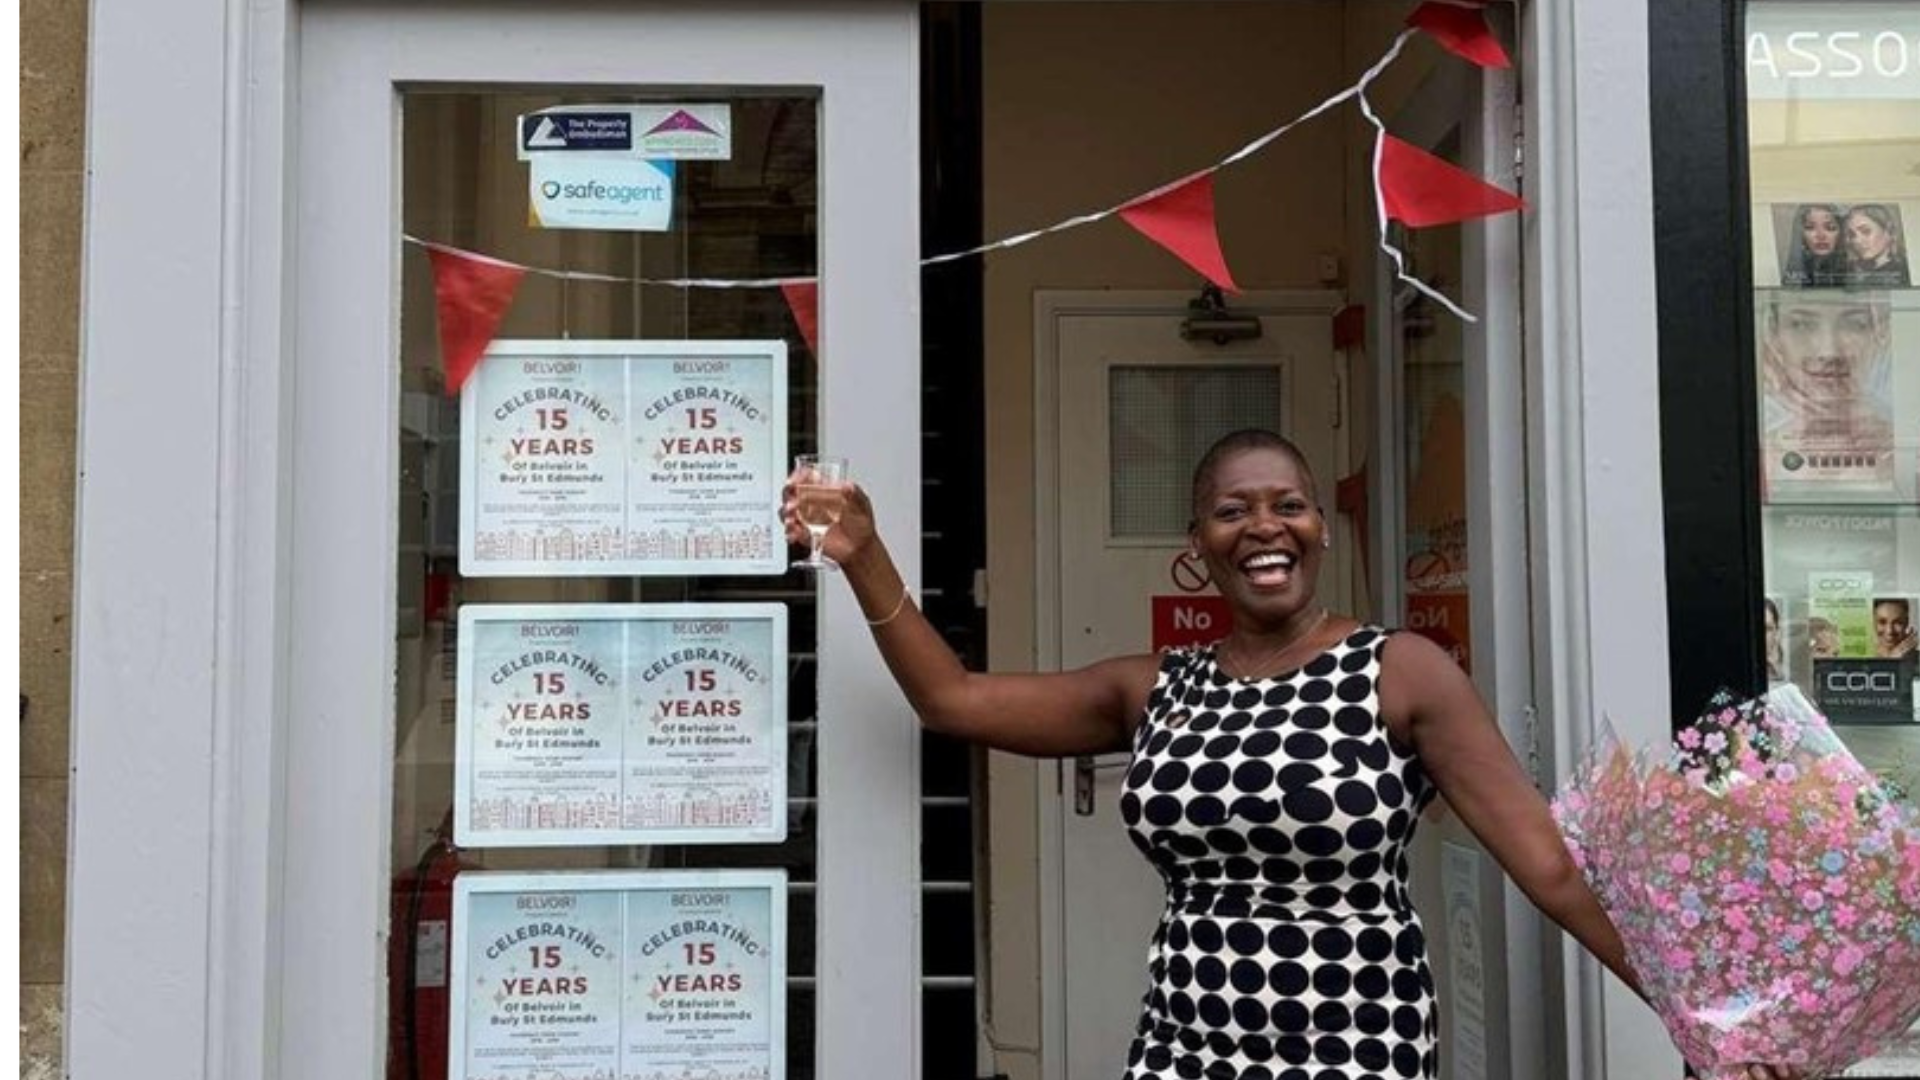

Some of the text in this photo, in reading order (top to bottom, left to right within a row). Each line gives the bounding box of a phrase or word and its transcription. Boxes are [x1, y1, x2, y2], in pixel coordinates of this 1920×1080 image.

[1747, 31, 1920, 78] ASSO
[569, 119, 584, 128] The
[564, 181, 664, 203] safeagent
[523, 362, 581, 374] BELVOIR!
[673, 362, 731, 373] BELVOIR!
[494, 387, 610, 422] CELEBRATING
[644, 386, 759, 420] CELEBRATING
[535, 409, 568, 430] 15
[686, 408, 718, 429] 15
[511, 438, 594, 455] YEARS
[661, 437, 743, 454] YEARS
[531, 462, 572, 470] Belvoir
[577, 462, 588, 470] in
[681, 461, 722, 469] Belvoir
[726, 461, 737, 469] in
[500, 474, 603, 483] Bury St Edmunds
[651, 473, 753, 482] Bury St Edmunds
[1173, 607, 1213, 630] No
[521, 626, 579, 637] BELVOIR!
[673, 622, 730, 634] BELVOIR!
[491, 650, 608, 686] CELEBRATING
[642, 648, 759, 683] CELEBRATING
[533, 673, 565, 694] 15
[685, 670, 716, 691] 15
[507, 704, 591, 720] YEARS
[659, 700, 742, 717] YEARS
[509, 727, 584, 736] Of Belvoir in
[678, 724, 720, 732] Belvoir
[496, 739, 600, 749] Bury St Edmunds
[648, 737, 675, 746] Bury
[695, 736, 752, 744] Edmunds
[517, 896, 576, 909] BELVOIR!
[671, 894, 730, 906] BELVOIR!
[486, 922, 606, 960] CELEBRATING
[641, 920, 760, 957] CELEBRATING
[528, 946, 561, 968] 15
[683, 943, 716, 964] 15
[503, 977, 588, 995] YEARS
[657, 974, 741, 992] YEARS
[505, 1002, 581, 1012] Of Belvoir in
[659, 998, 736, 1008] Of Belvoir in
[491, 1014, 597, 1026] Bury St Edmunds
[646, 1011, 752, 1021] Bury St Edmunds
